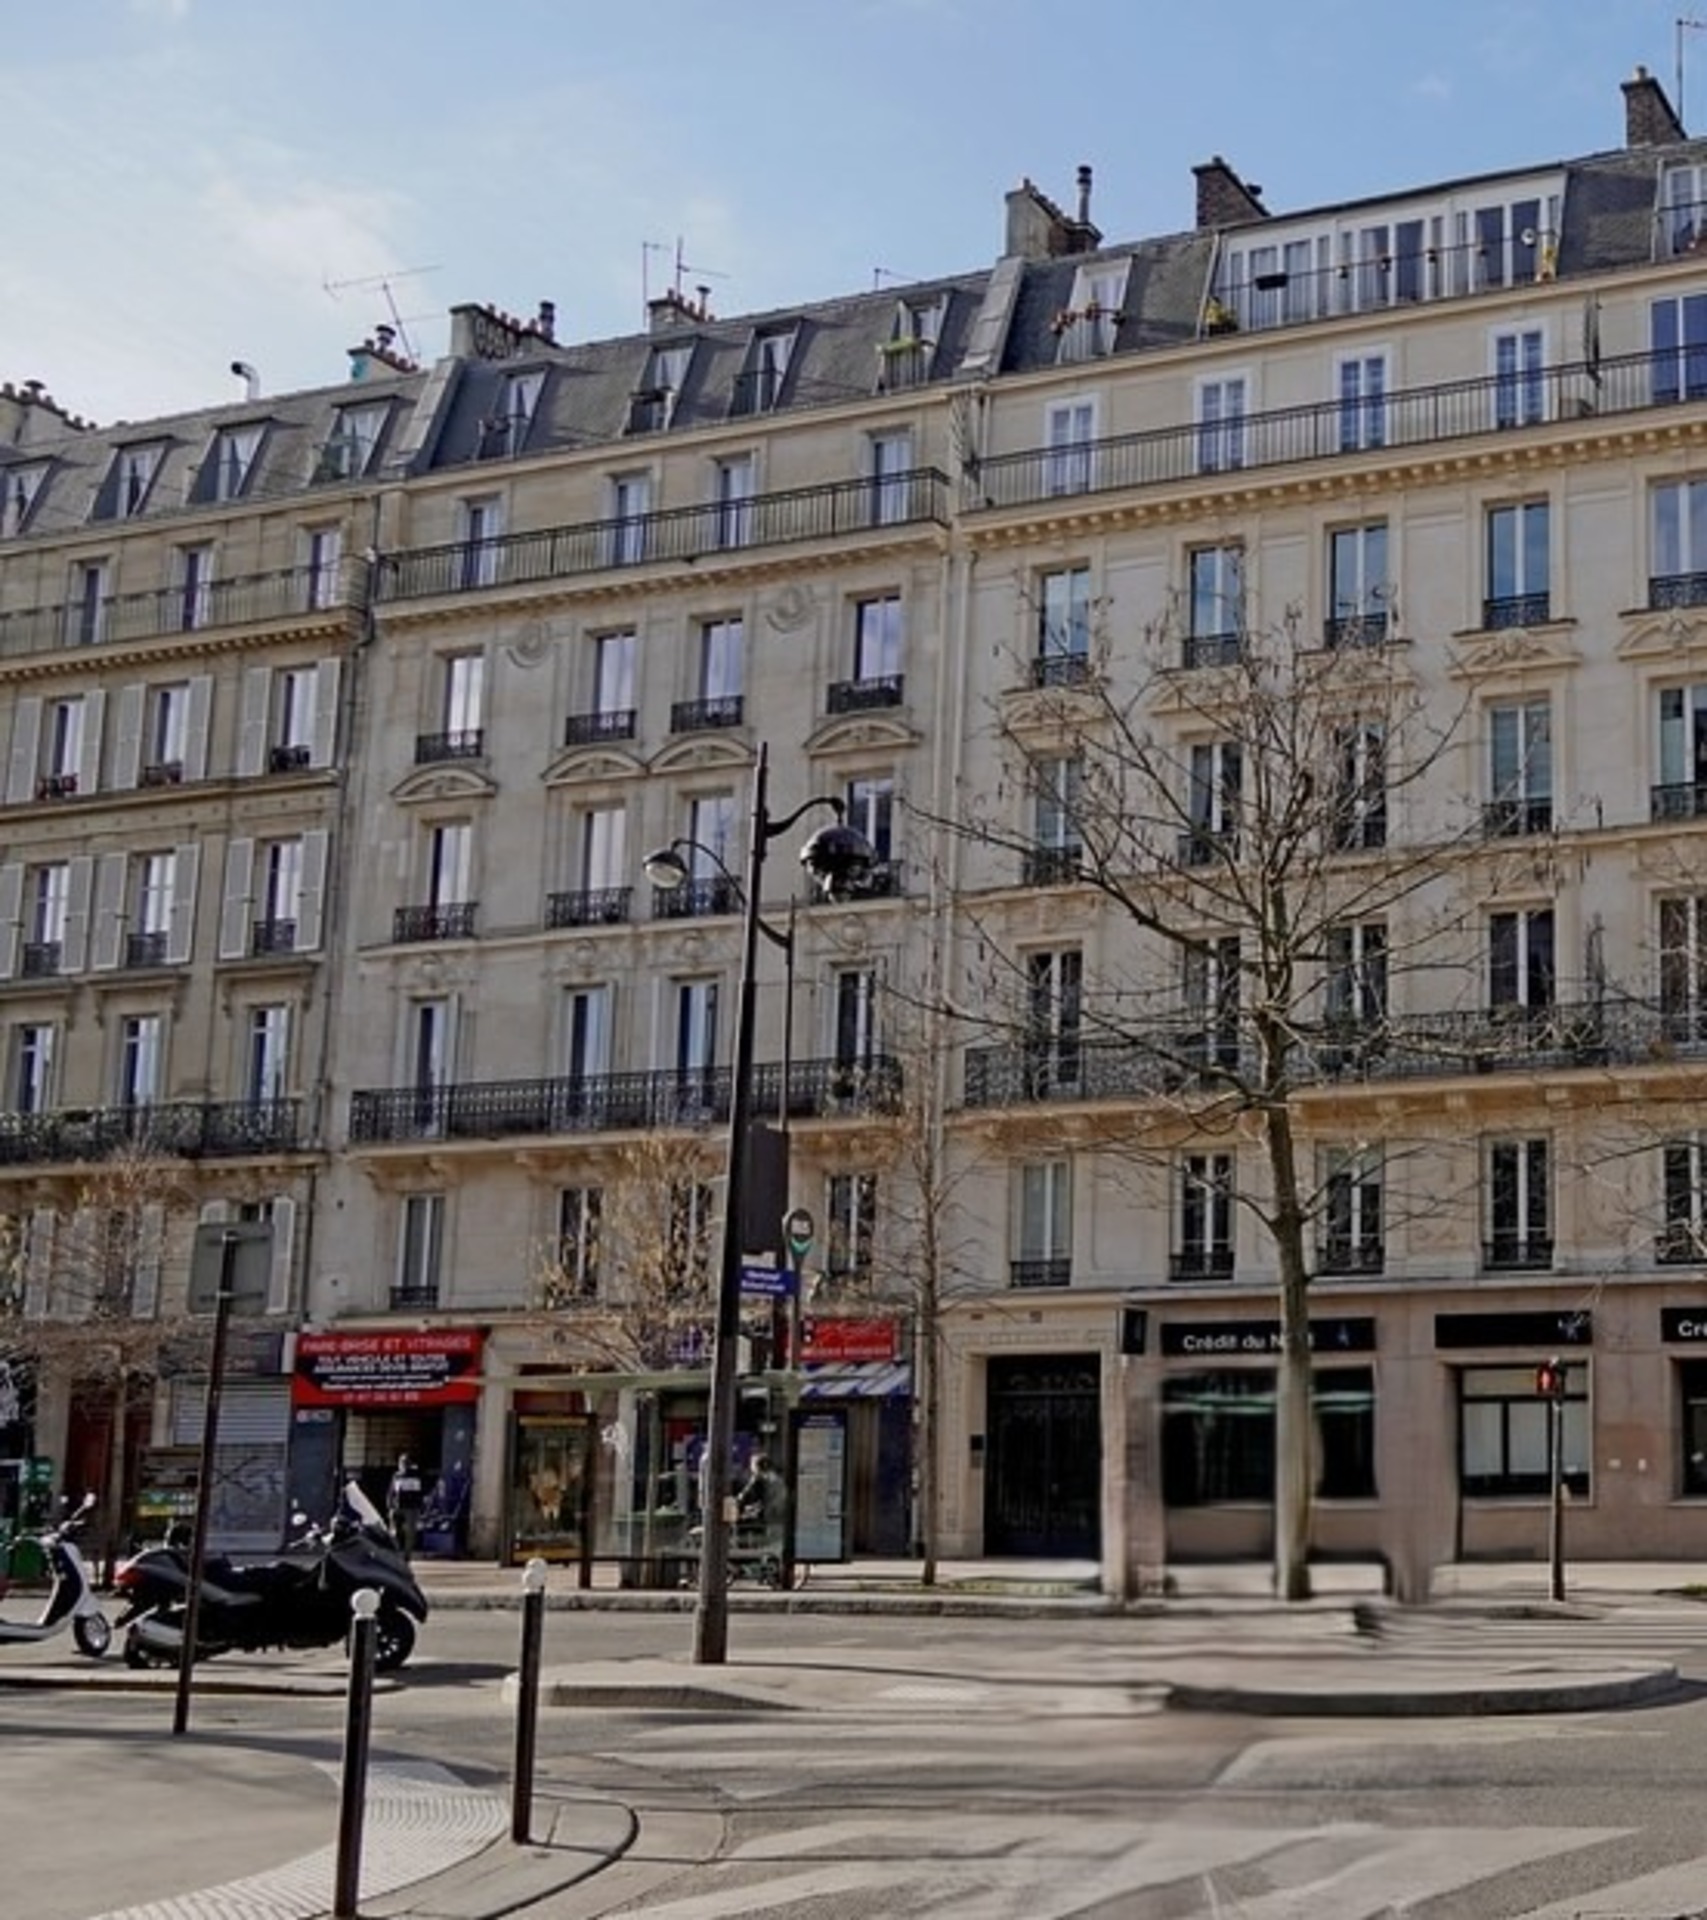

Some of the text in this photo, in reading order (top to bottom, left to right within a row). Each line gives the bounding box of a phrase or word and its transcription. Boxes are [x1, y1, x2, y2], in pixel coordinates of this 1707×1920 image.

[383, 1337, 401, 1351] ET
[1183, 1334, 1238, 1351] Crédit
[1242, 1333, 1266, 1350] du
